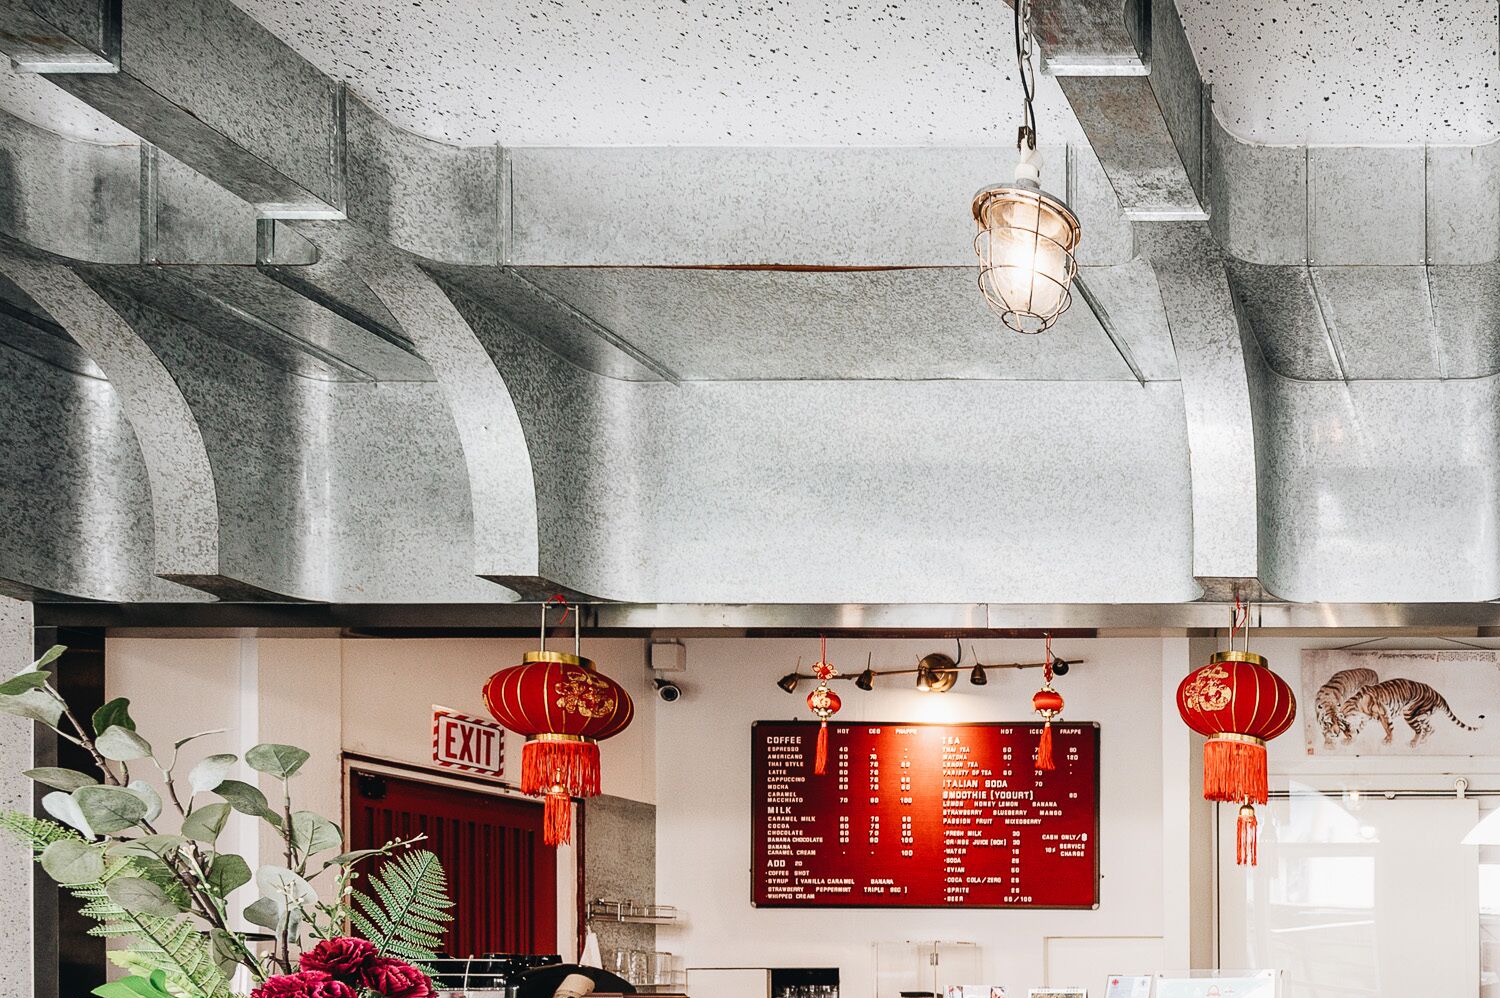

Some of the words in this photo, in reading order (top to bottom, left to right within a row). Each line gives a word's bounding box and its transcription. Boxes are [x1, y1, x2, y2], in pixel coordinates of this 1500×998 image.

[445, 721, 496, 767] EXIT
[767, 736, 802, 744] COFFEE
[942, 736, 961, 745] TEA
[943, 780, 978, 788] ITALIAN
[985, 780, 1008, 788] SODA
[943, 790, 987, 799] SMOOTHIE
[768, 806, 792, 814] MILK
[1042, 833, 1059, 841] CASH
[767, 859, 785, 867] ADD
